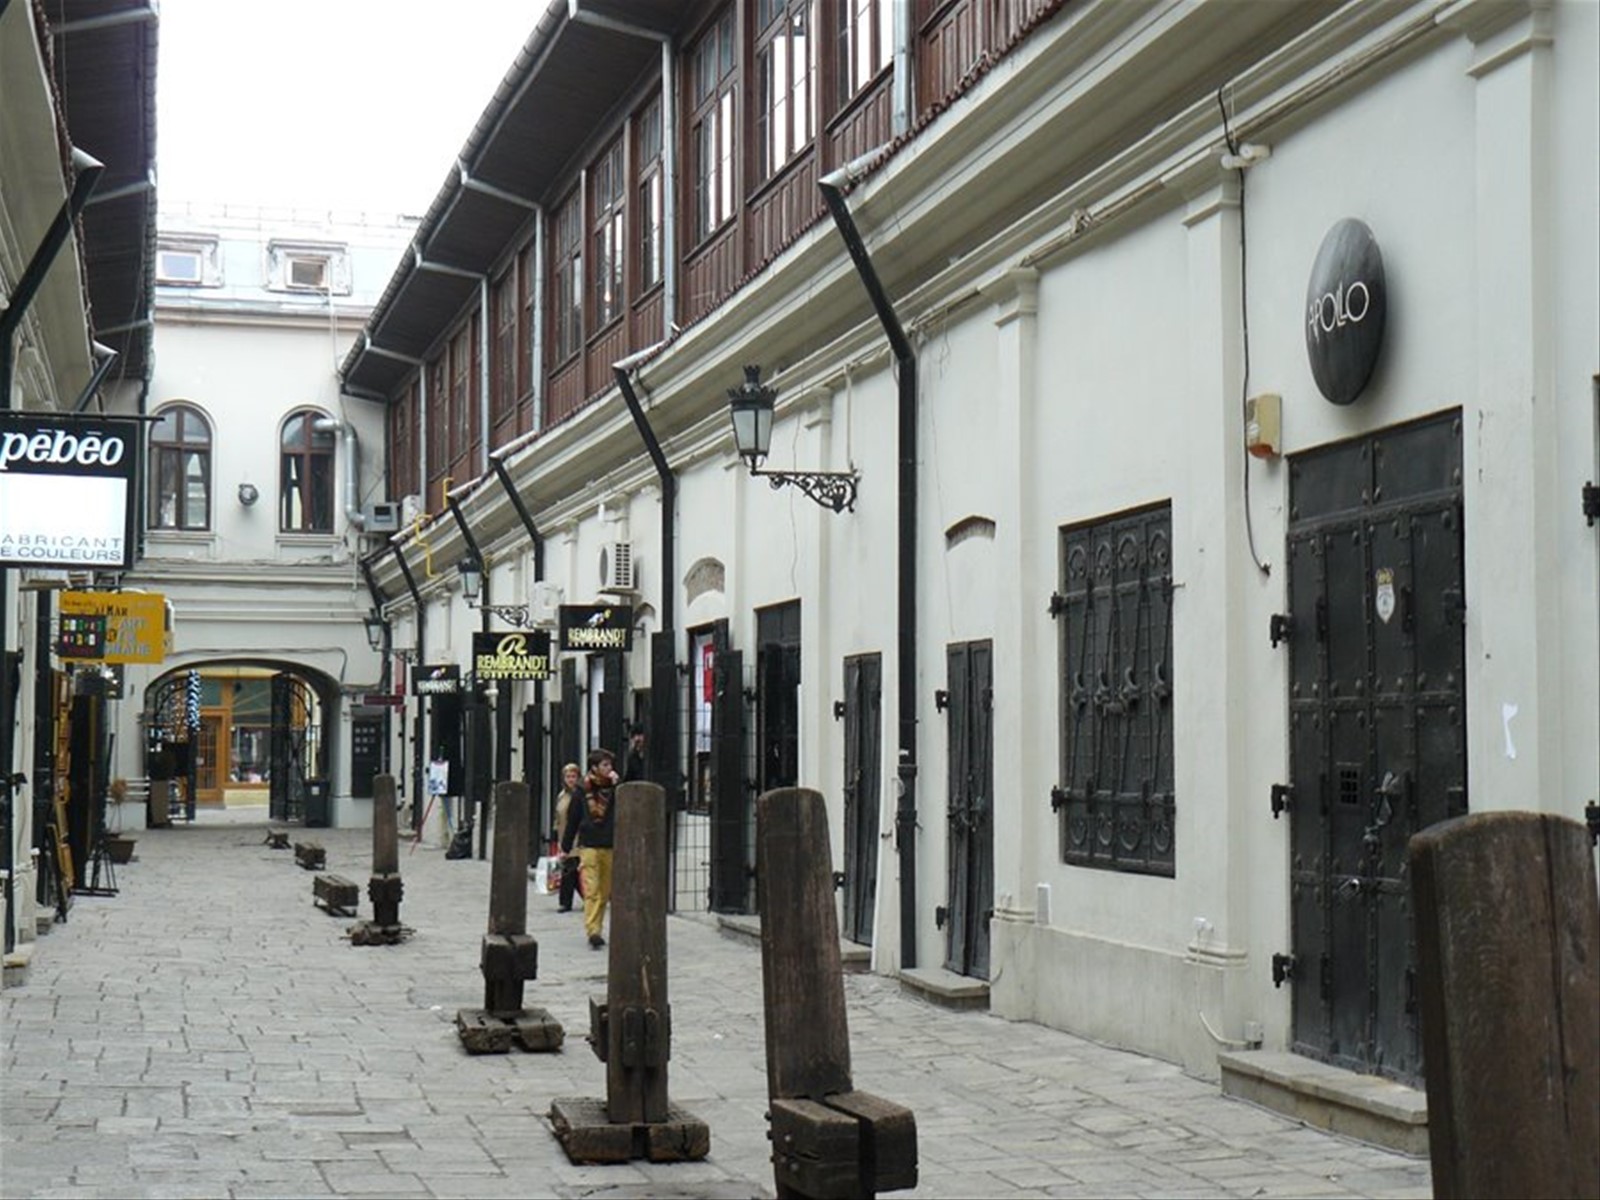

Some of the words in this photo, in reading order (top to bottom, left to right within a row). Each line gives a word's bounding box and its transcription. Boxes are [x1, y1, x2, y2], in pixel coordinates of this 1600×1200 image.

[1307, 280, 1370, 343] APOLLO
[18, 546, 121, 561] COULEURS
[568, 628, 627, 641] REMBRANDT
[476, 655, 548, 670] REMBRANDT
